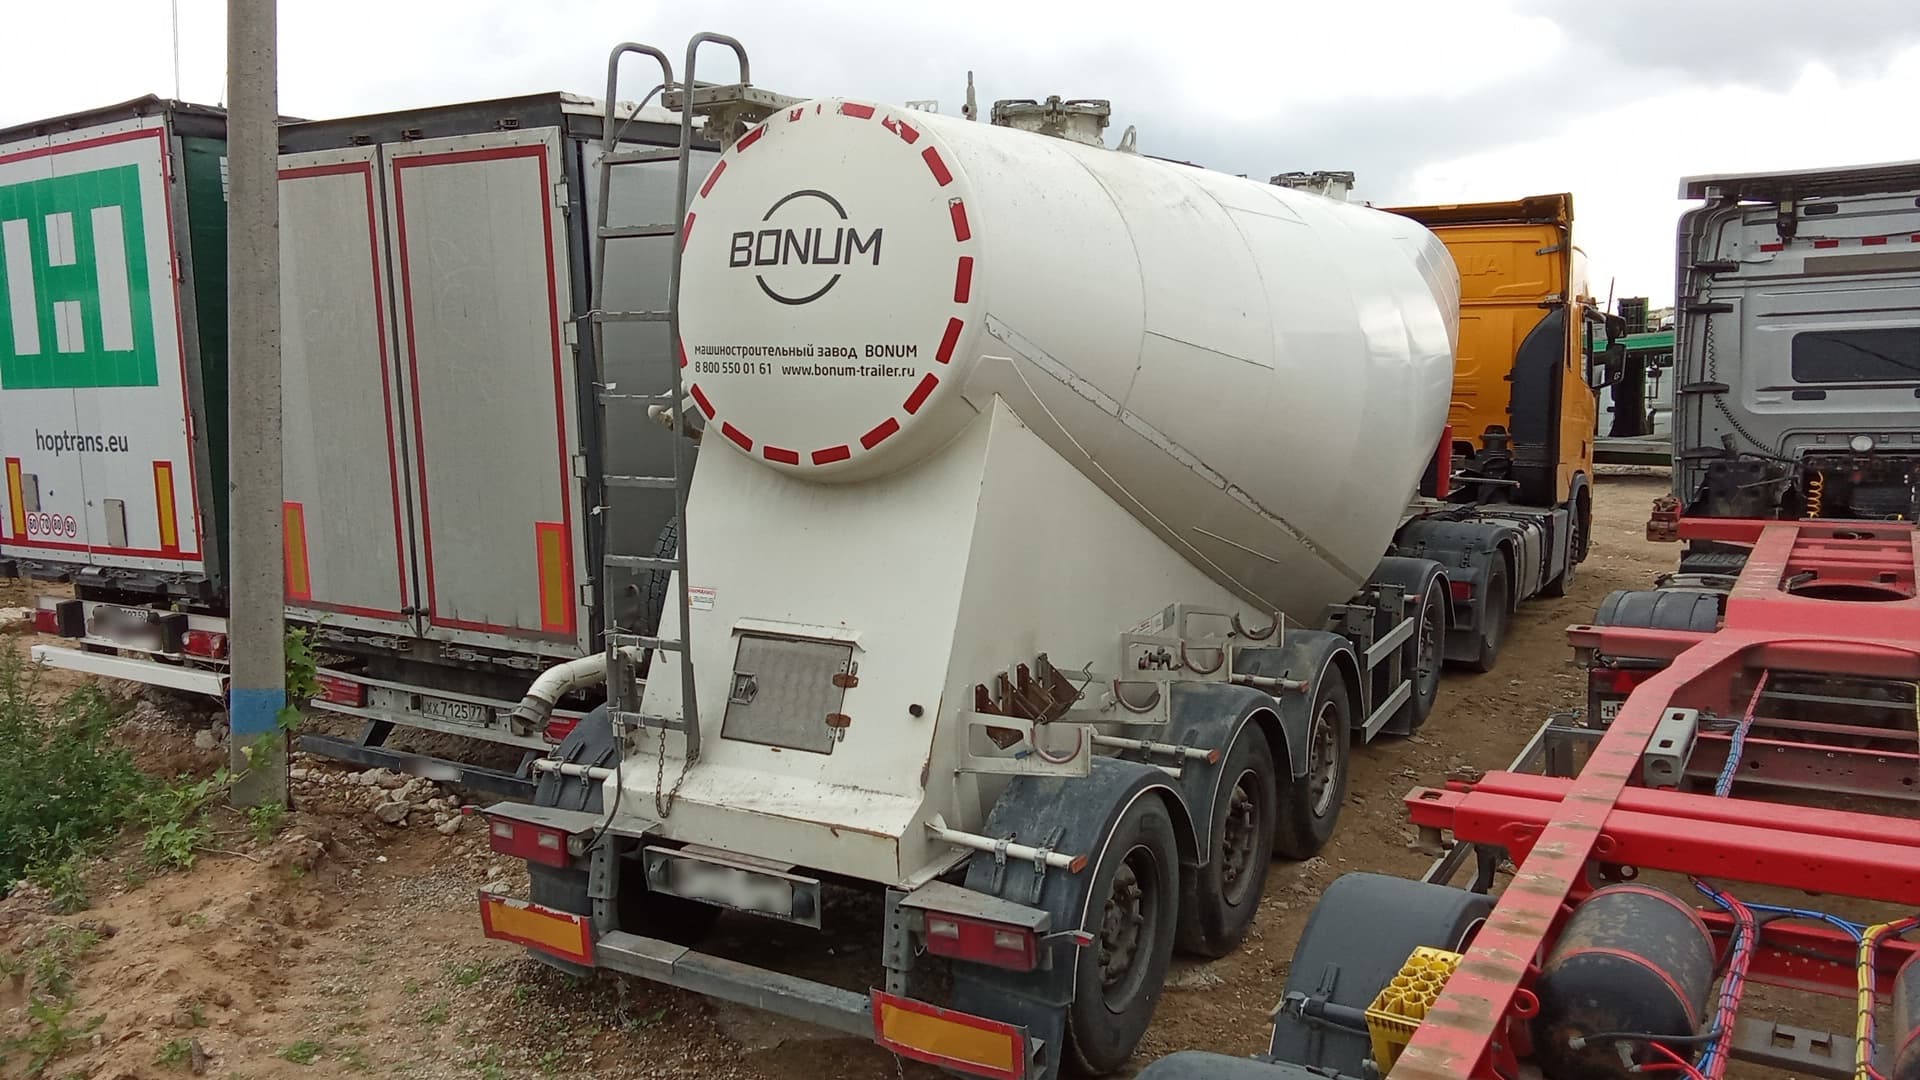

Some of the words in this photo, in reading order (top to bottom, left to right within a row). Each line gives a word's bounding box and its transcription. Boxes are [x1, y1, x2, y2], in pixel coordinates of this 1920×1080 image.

[729, 228, 883, 268] BONUM
[694, 344, 814, 359] машиностроительный
[817, 347, 858, 359] завод
[865, 344, 917, 358] BONUM
[702, 361, 720, 373] 800
[722, 362, 740, 374] 550
[781, 363, 915, 377] www.bonum-trailer.ru
[35, 428, 129, 457] hoptrans.eu
